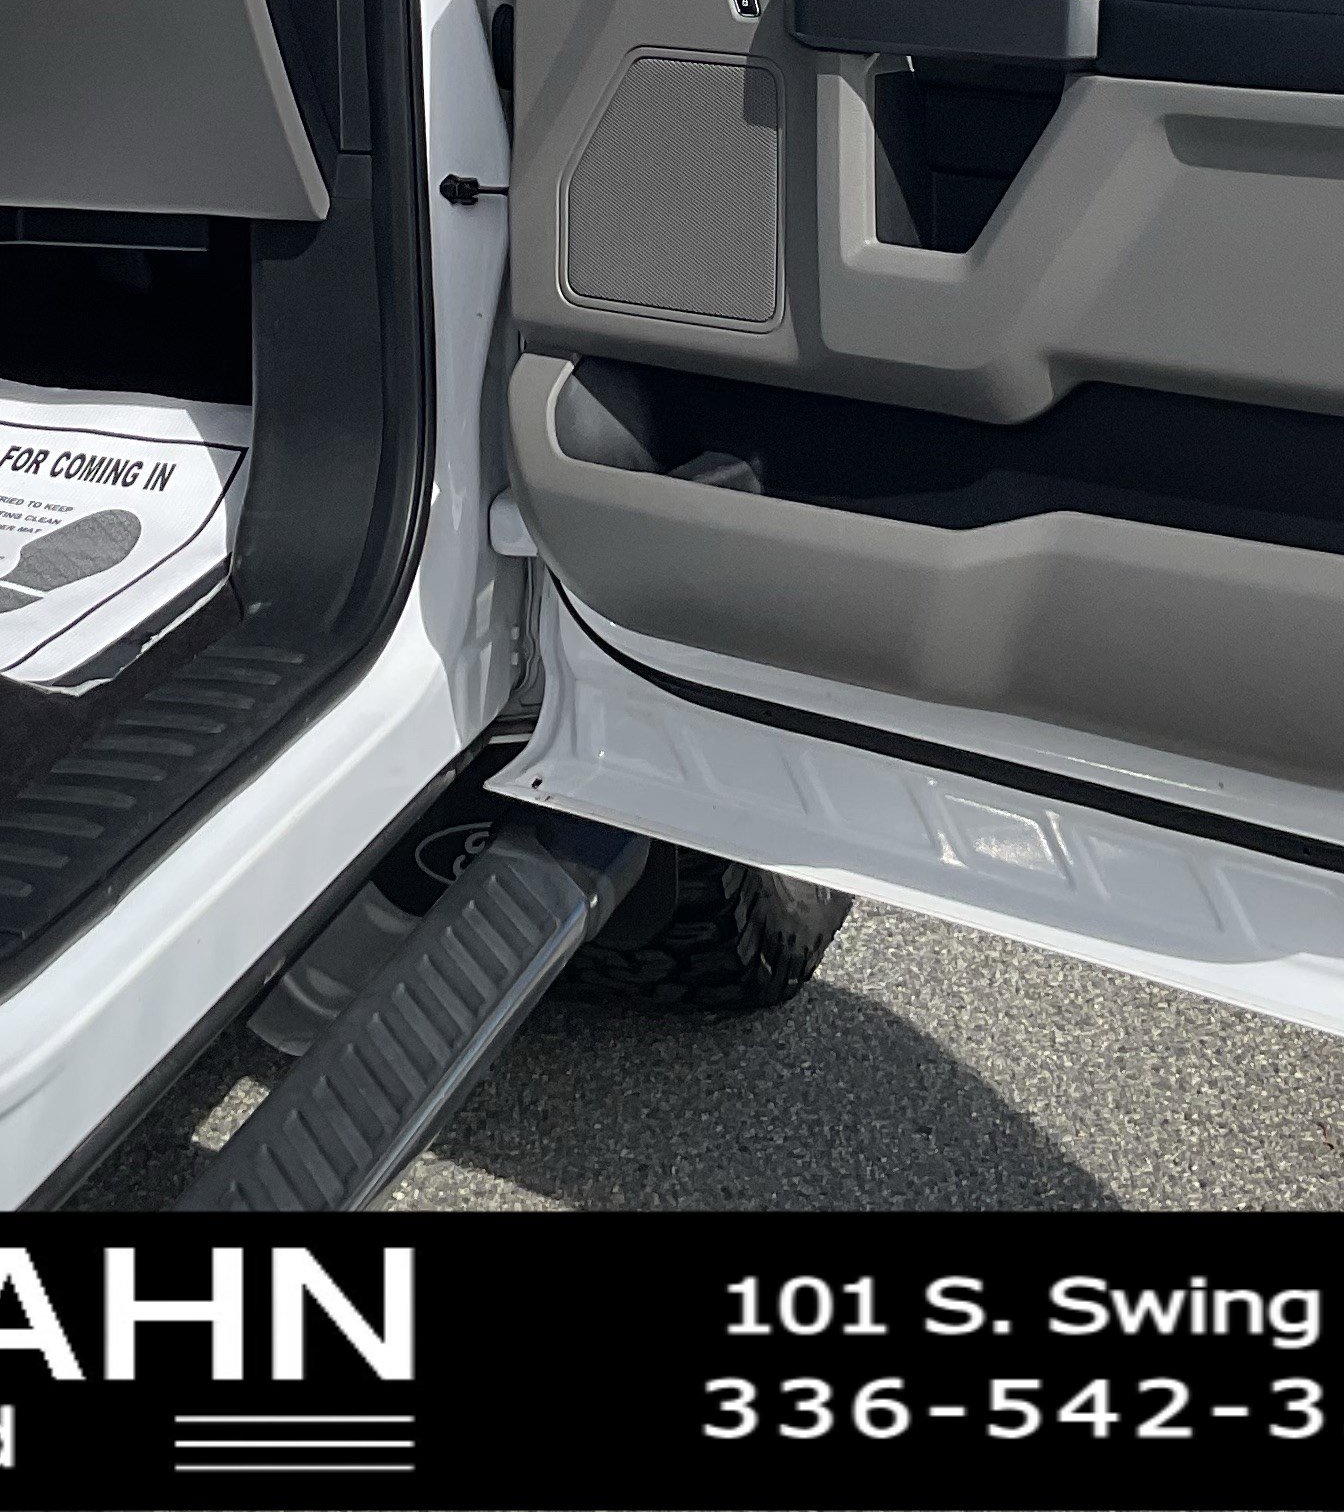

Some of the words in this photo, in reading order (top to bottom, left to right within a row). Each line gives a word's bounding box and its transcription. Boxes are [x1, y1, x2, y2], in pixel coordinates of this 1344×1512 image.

[49, 450, 144, 489] COMING
[142, 461, 177, 492] IN
[28, 500, 42, 509] TO
[44, 503, 74, 513] KEEP
[24, 515, 62, 525] CLEAN
